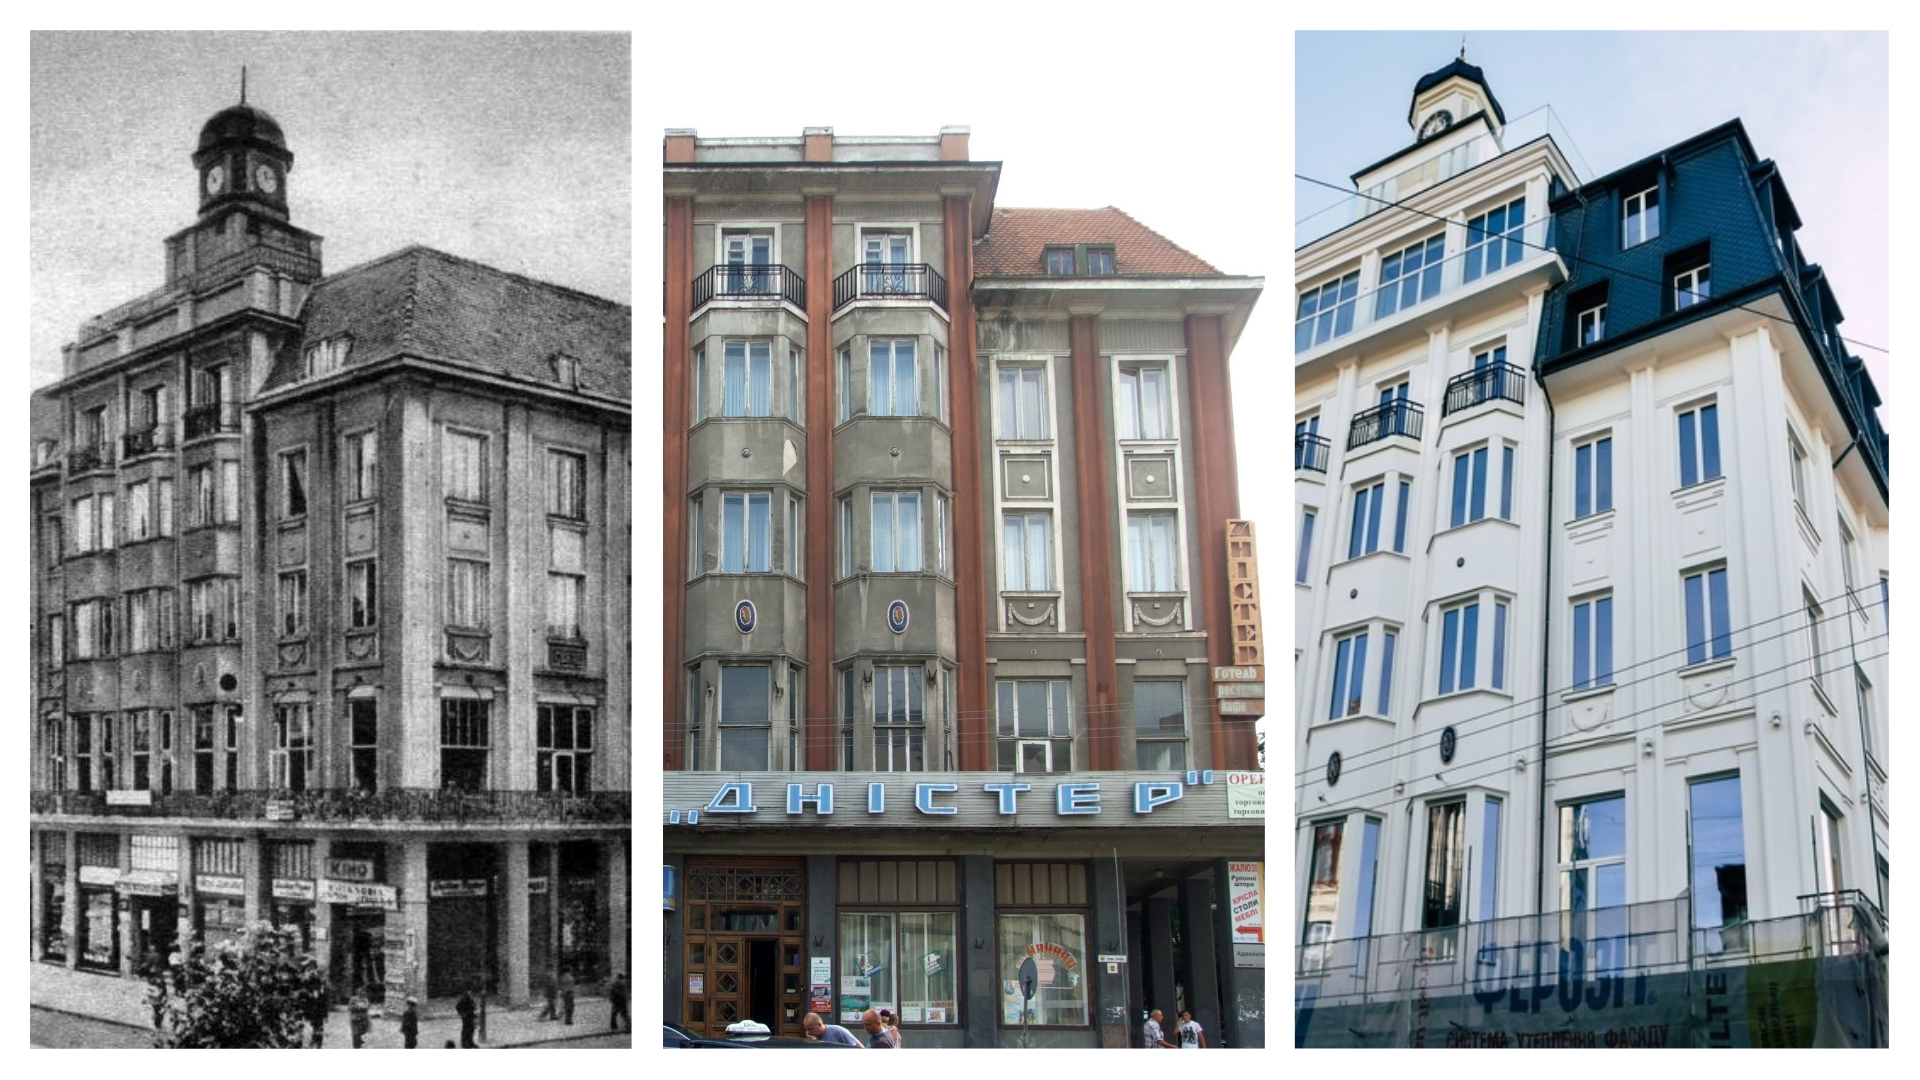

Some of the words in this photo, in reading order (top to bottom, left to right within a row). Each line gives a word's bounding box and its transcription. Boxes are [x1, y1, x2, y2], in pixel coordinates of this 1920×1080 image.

[1230, 521, 1258, 663] ДНІСТЕР
[1214, 666, 1257, 680] Готель
[1229, 863, 1258, 873] ЖАЛЮЗІ
[1231, 874, 1257, 882] Рулонні
[1232, 889, 1259, 905] КРІСЛА
[1233, 899, 1259, 914] СТОЛИ
[1234, 908, 1258, 923] МЕБЛІ
[1604, 1024, 1670, 1048] ФАСАДУ
